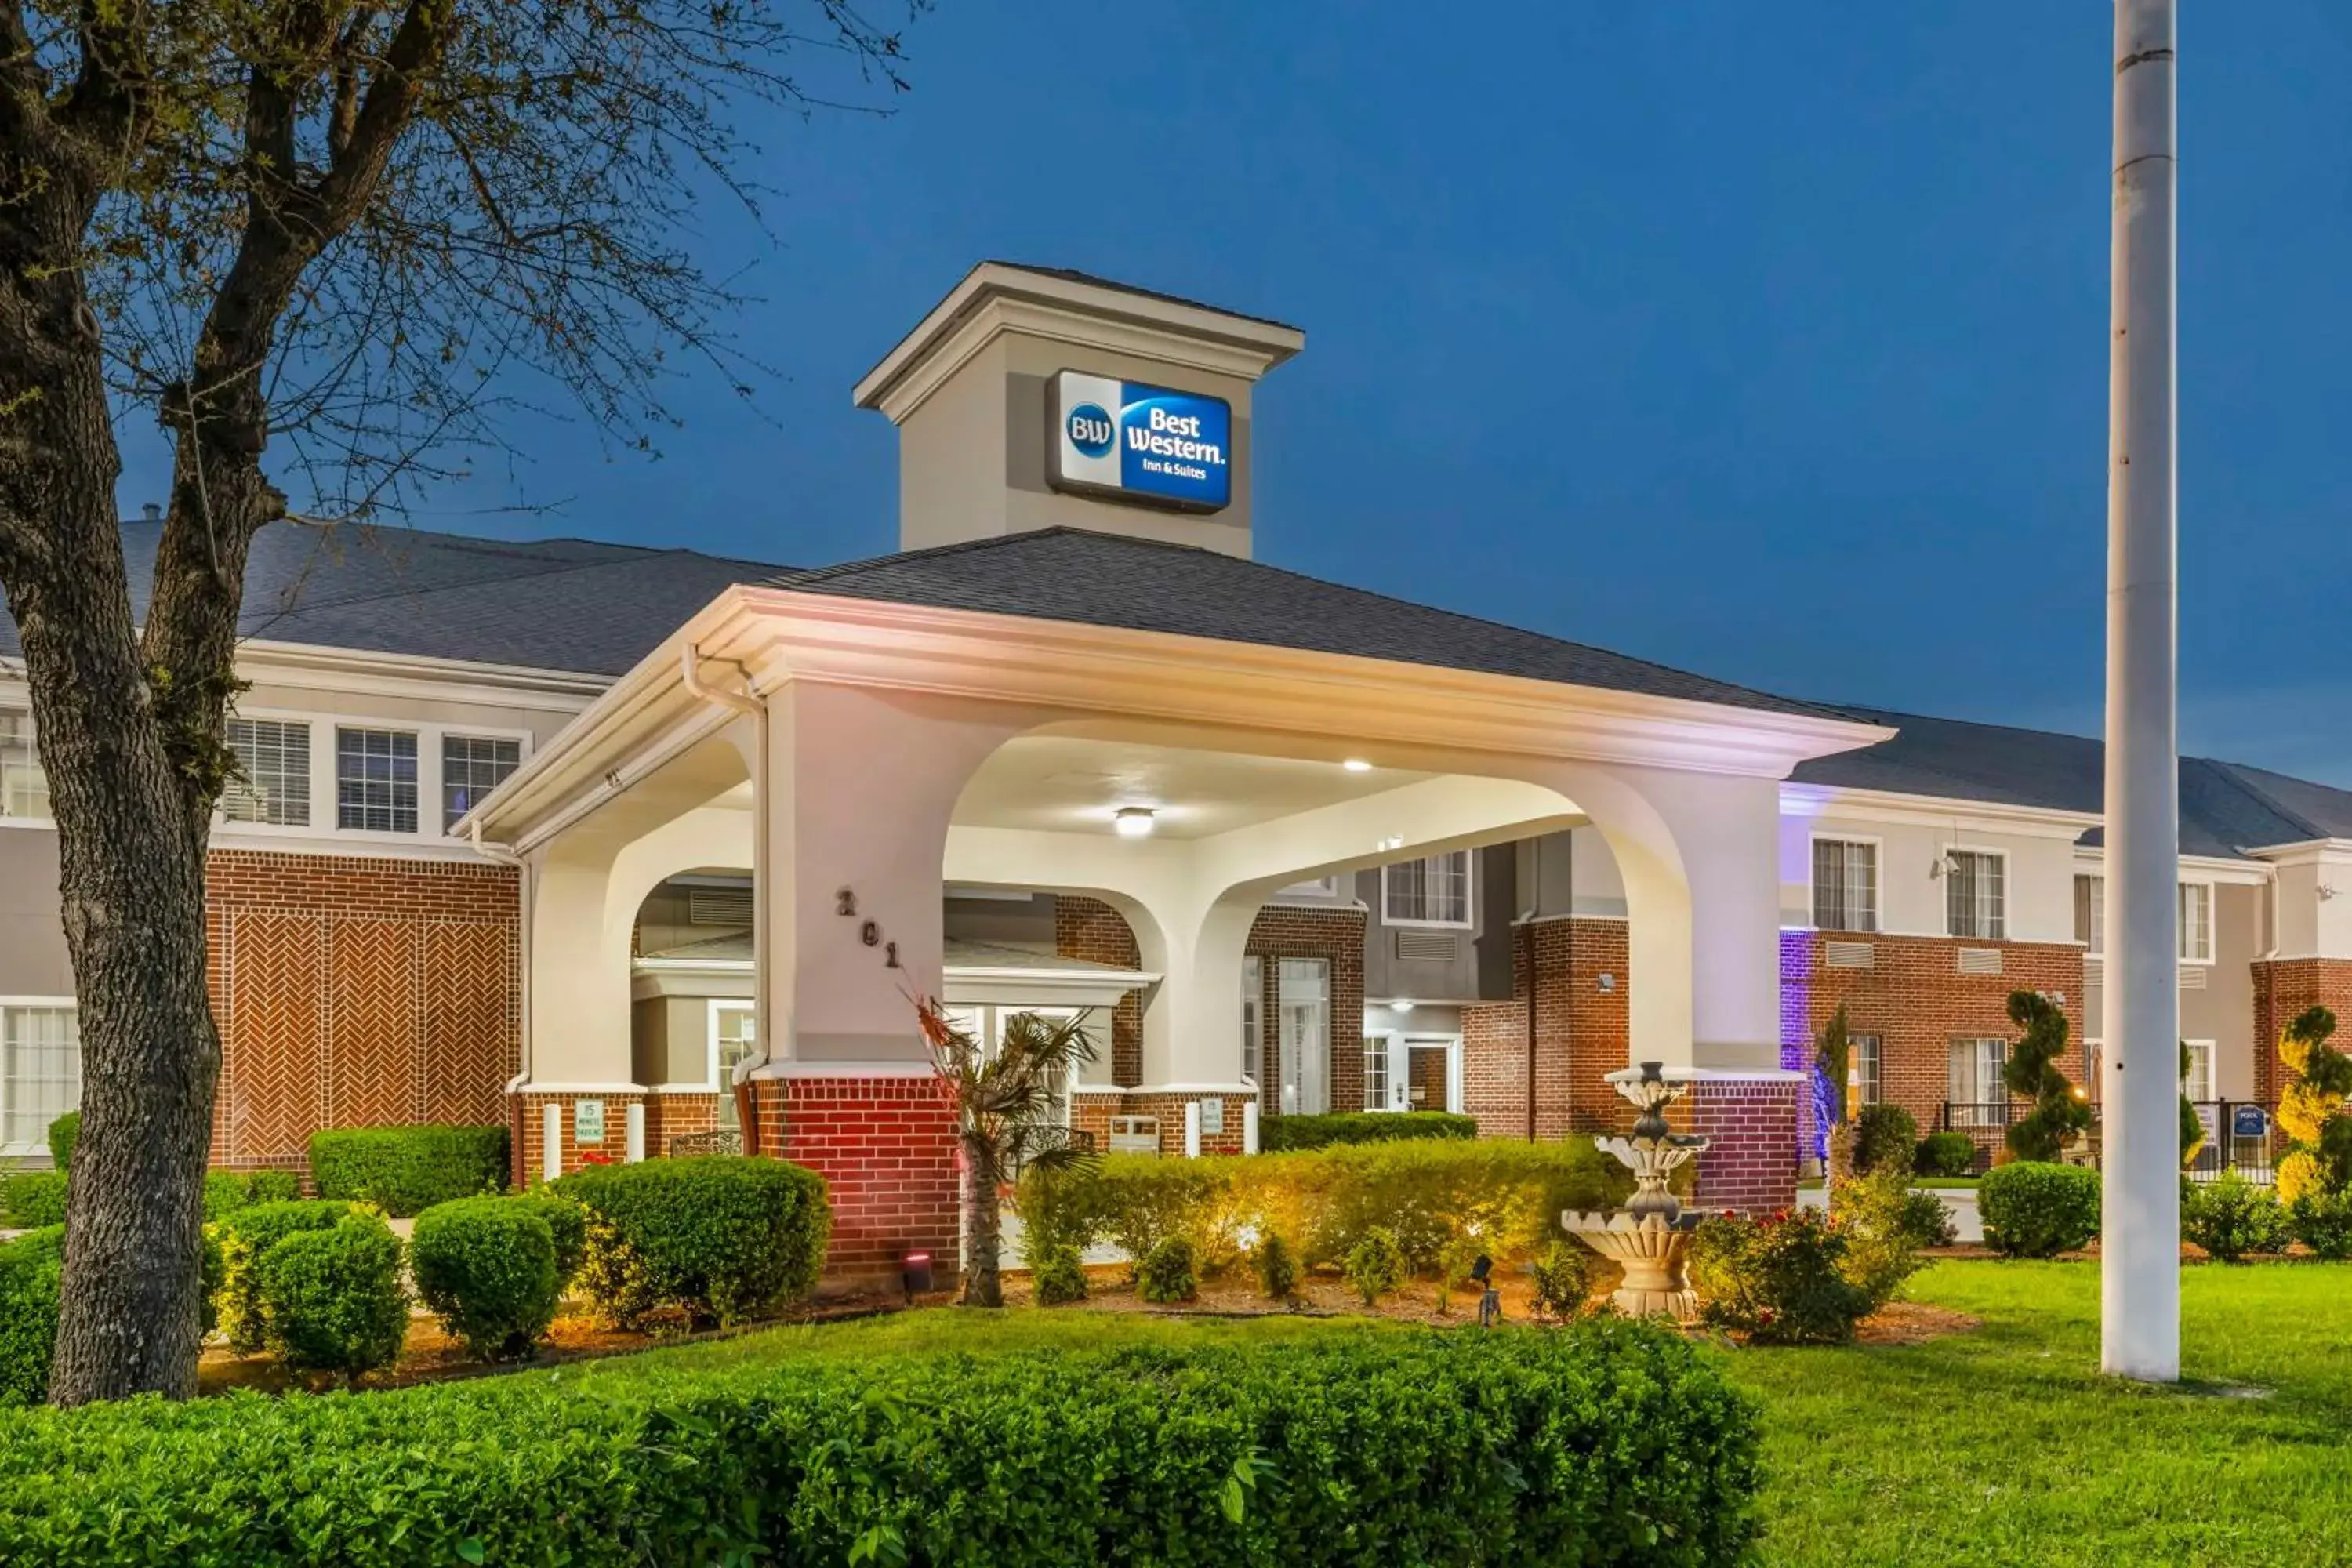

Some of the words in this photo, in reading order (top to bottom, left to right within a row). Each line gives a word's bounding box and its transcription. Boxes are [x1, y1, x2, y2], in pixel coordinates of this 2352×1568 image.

[1072, 416, 1111, 445] BW
[1150, 407, 1200, 437] Best
[1142, 458, 1161, 472] Inn
[1163, 462, 1172, 474] &
[1173, 463, 1207, 480] Suites
